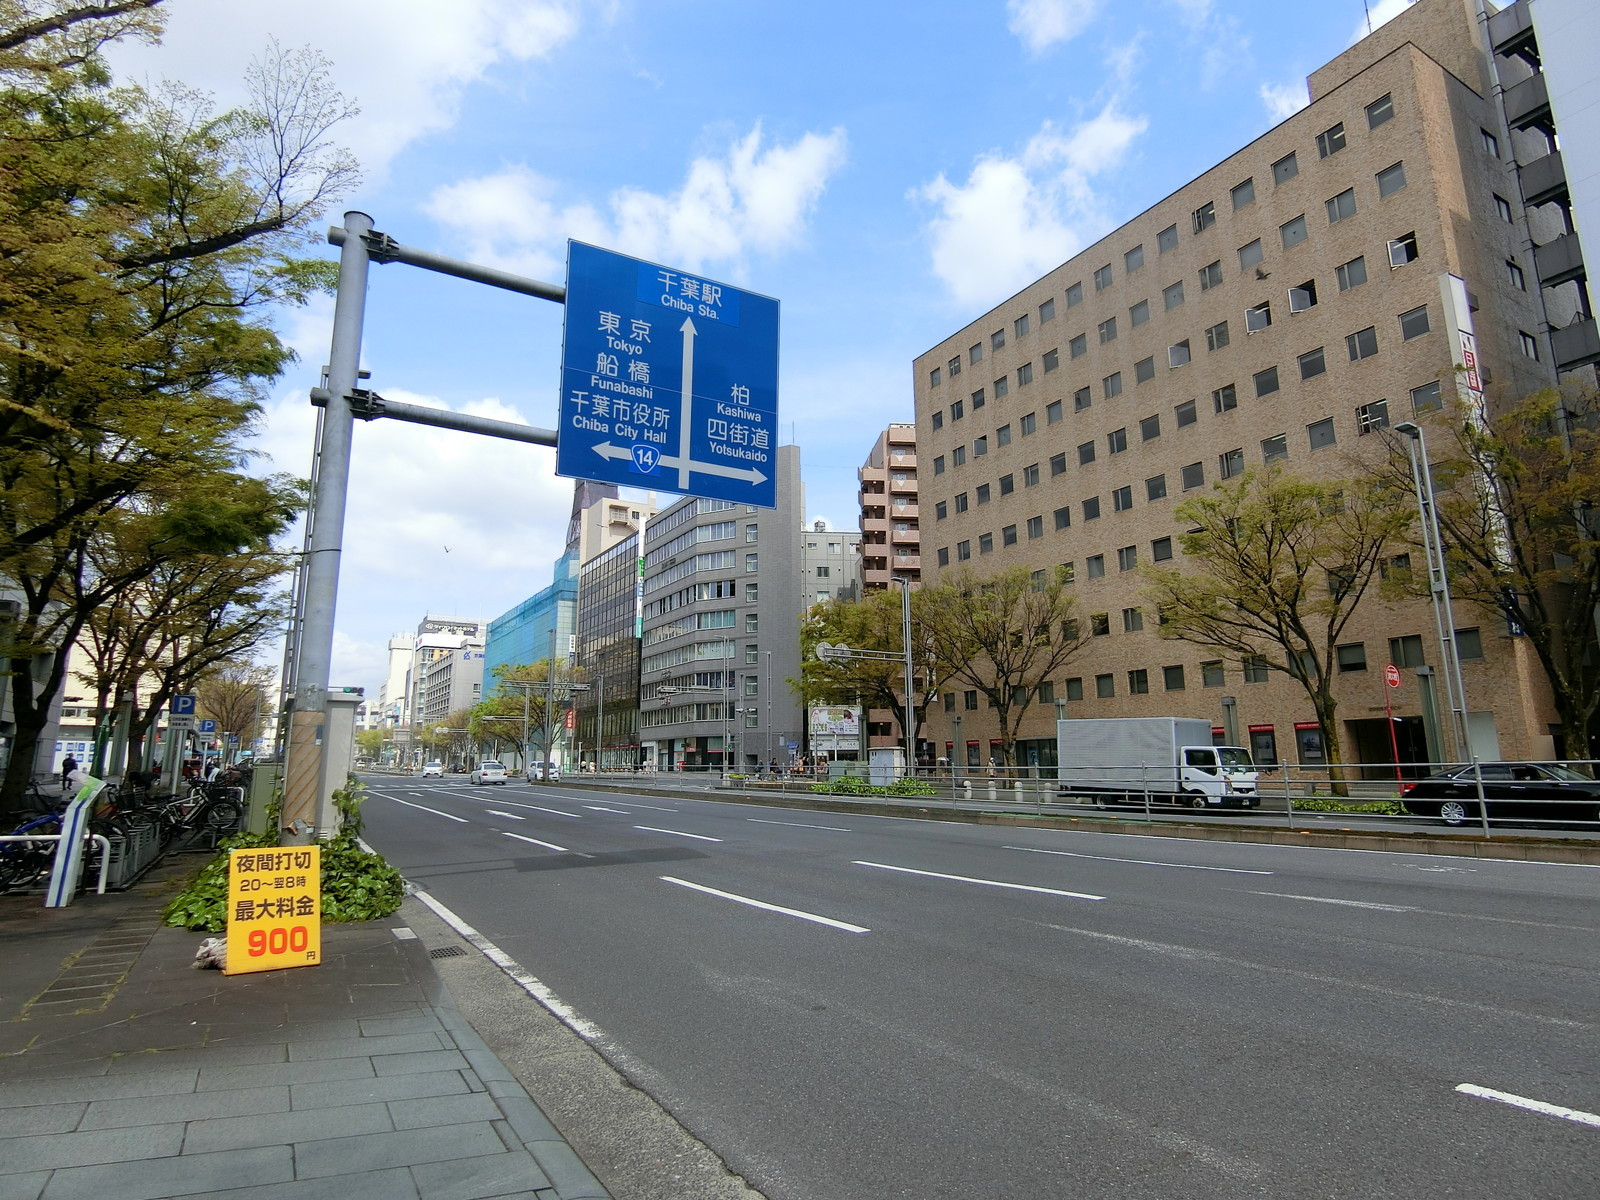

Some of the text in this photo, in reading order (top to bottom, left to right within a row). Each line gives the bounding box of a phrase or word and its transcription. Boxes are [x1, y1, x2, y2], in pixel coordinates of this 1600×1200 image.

[657, 270, 723, 308] 千葉駅
[661, 294, 720, 320] Chiba Sta.
[598, 310, 652, 343] 東京
[606, 335, 643, 355] Tokyo
[596, 351, 650, 384] 船橋
[591, 376, 653, 399] Funabashi
[731, 383, 750, 406] 柏
[570, 390, 670, 430] 千葉市役所
[717, 402, 762, 423] Kashiwa
[572, 416, 667, 444] Chiba City Hall
[707, 418, 770, 450] 四街道
[636, 449, 653, 466] 14
[709, 441, 768, 463] Yotsukaido
[177, 697, 192, 712] P
[204, 721, 214, 731] P
[236, 851, 312, 873] 夜間打切
[235, 895, 315, 921] 最大料金
[248, 925, 308, 957] 900
[306, 951, 316, 960] 円
